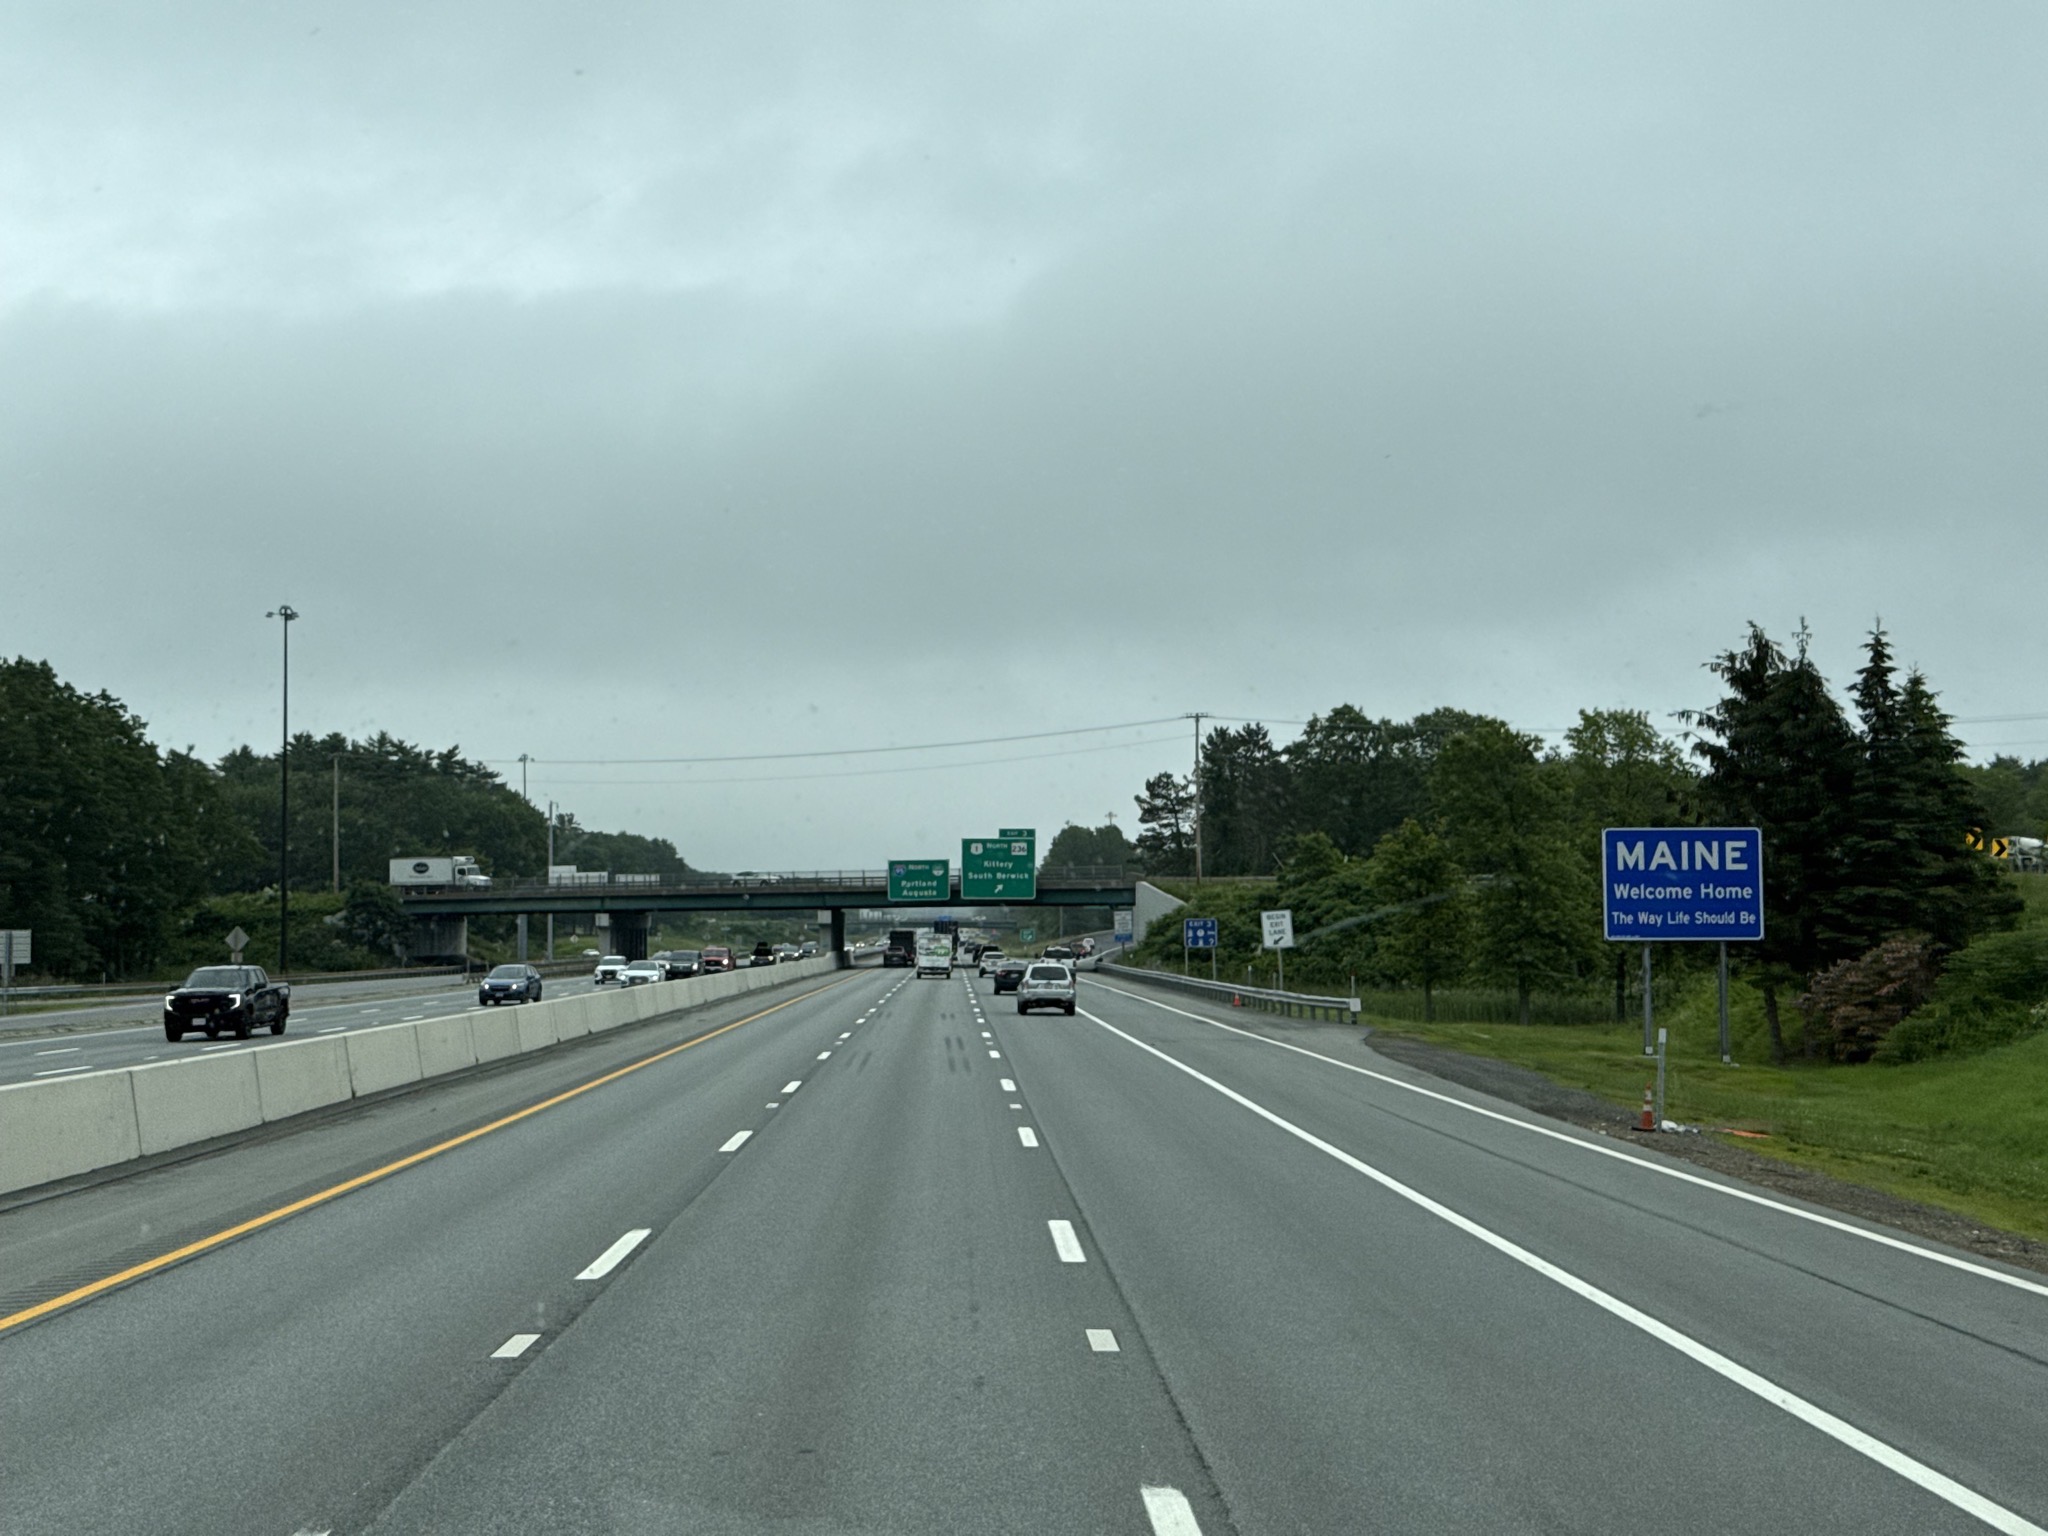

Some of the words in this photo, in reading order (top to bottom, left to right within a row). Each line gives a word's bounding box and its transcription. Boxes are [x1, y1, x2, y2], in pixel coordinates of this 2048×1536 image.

[1012, 845, 1027, 853] 236
[1616, 840, 1748, 872] MAINE
[983, 860, 1014, 870] Kittery
[996, 872, 1029, 880] Berwick
[900, 880, 937, 888] Portland
[902, 889, 937, 898] Augusta
[1613, 883, 1693, 900] Welcome
[1700, 883, 1753, 899] Home
[1611, 911, 1634, 925] The
[1638, 911, 1663, 927] Way
[1667, 911, 1690, 925] Life
[1694, 911, 1735, 925] Should
[1740, 911, 1756, 924] Be
[1269, 920, 1284, 928] EXIT
[1268, 928, 1287, 936] LANE
